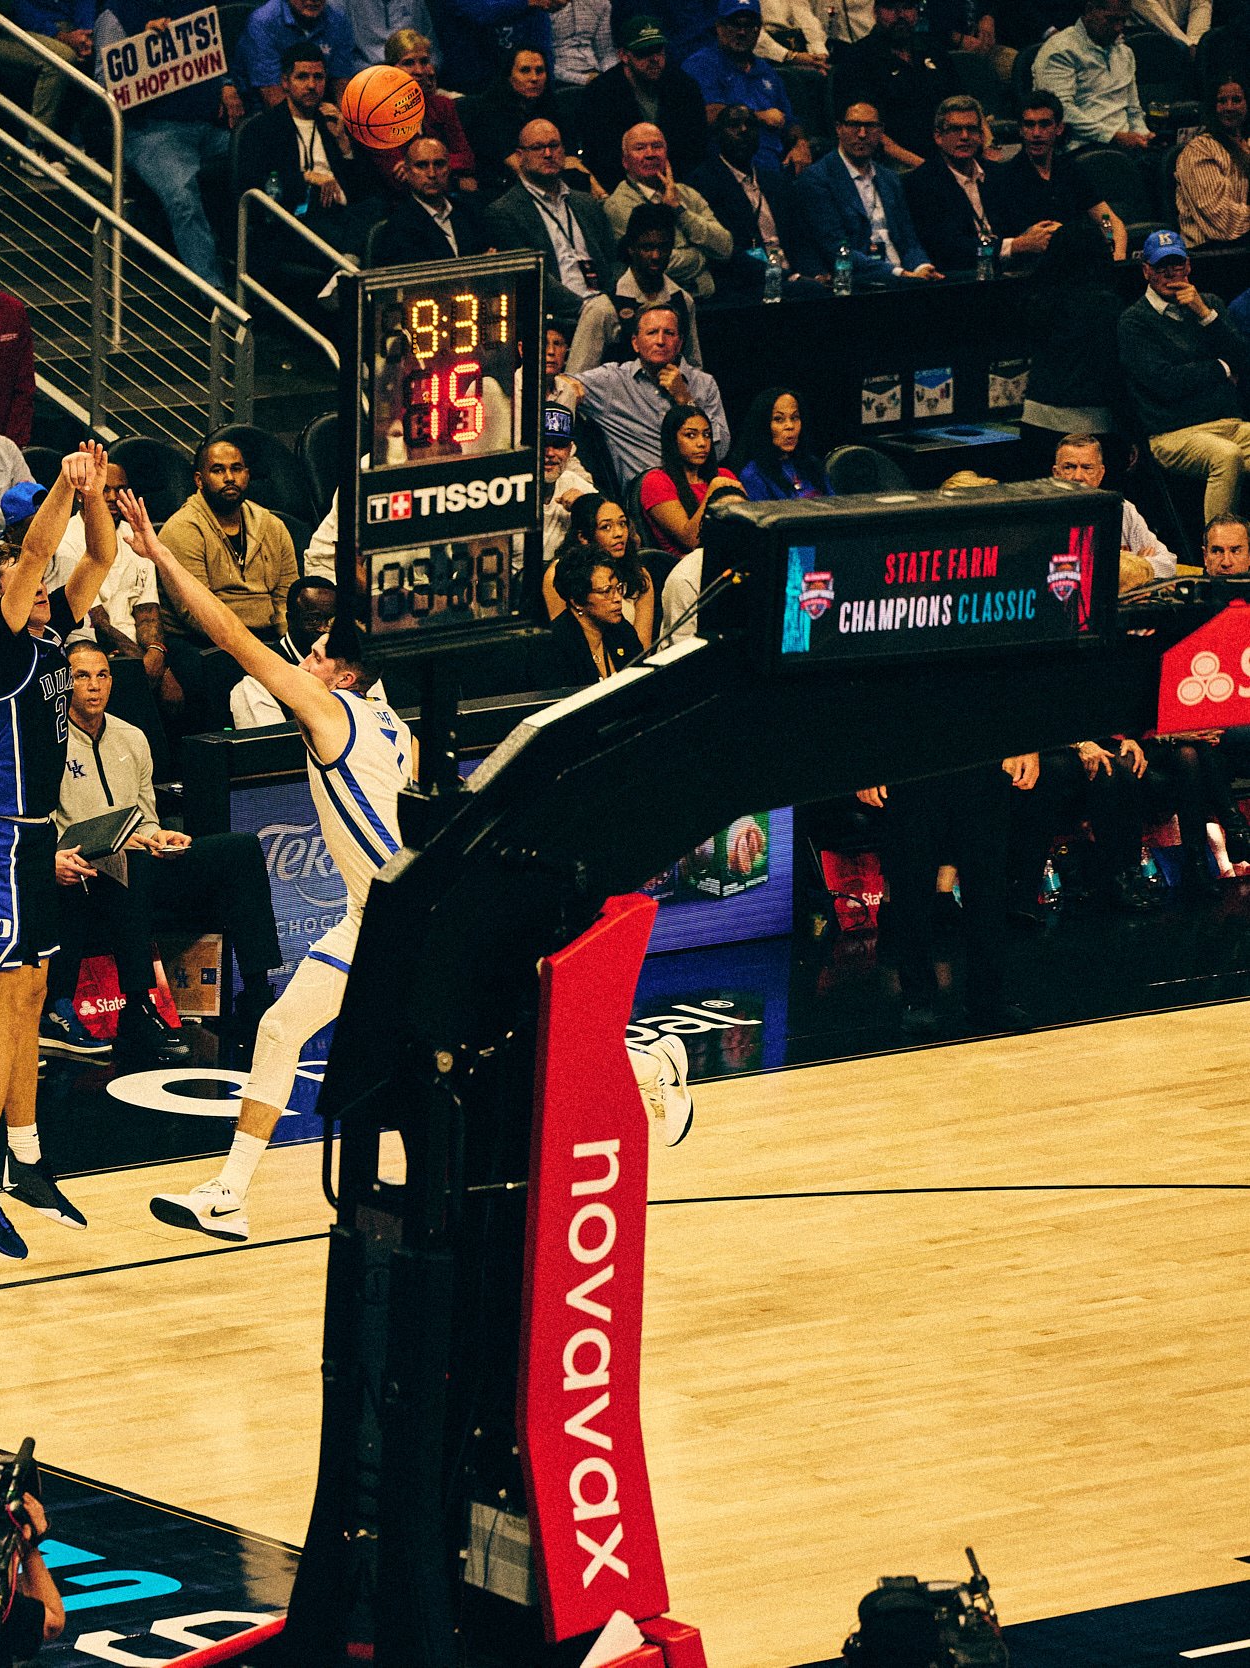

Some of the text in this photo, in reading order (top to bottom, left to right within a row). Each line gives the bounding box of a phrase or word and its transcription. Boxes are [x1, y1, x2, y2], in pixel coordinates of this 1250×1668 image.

[107, 12, 219, 83] GO CATS!
[135, 50, 223, 101] HOPTOWN
[431, 362, 484, 443] 15
[413, 472, 534, 517] TISSOT
[884, 545, 999, 585] STATE FARM
[838, 588, 1037, 634] CHAMPIONS CLASSIC
[54, 694, 69, 744] 2
[66, 759, 87, 779] UK
[562, 1138, 630, 1590] novavax
